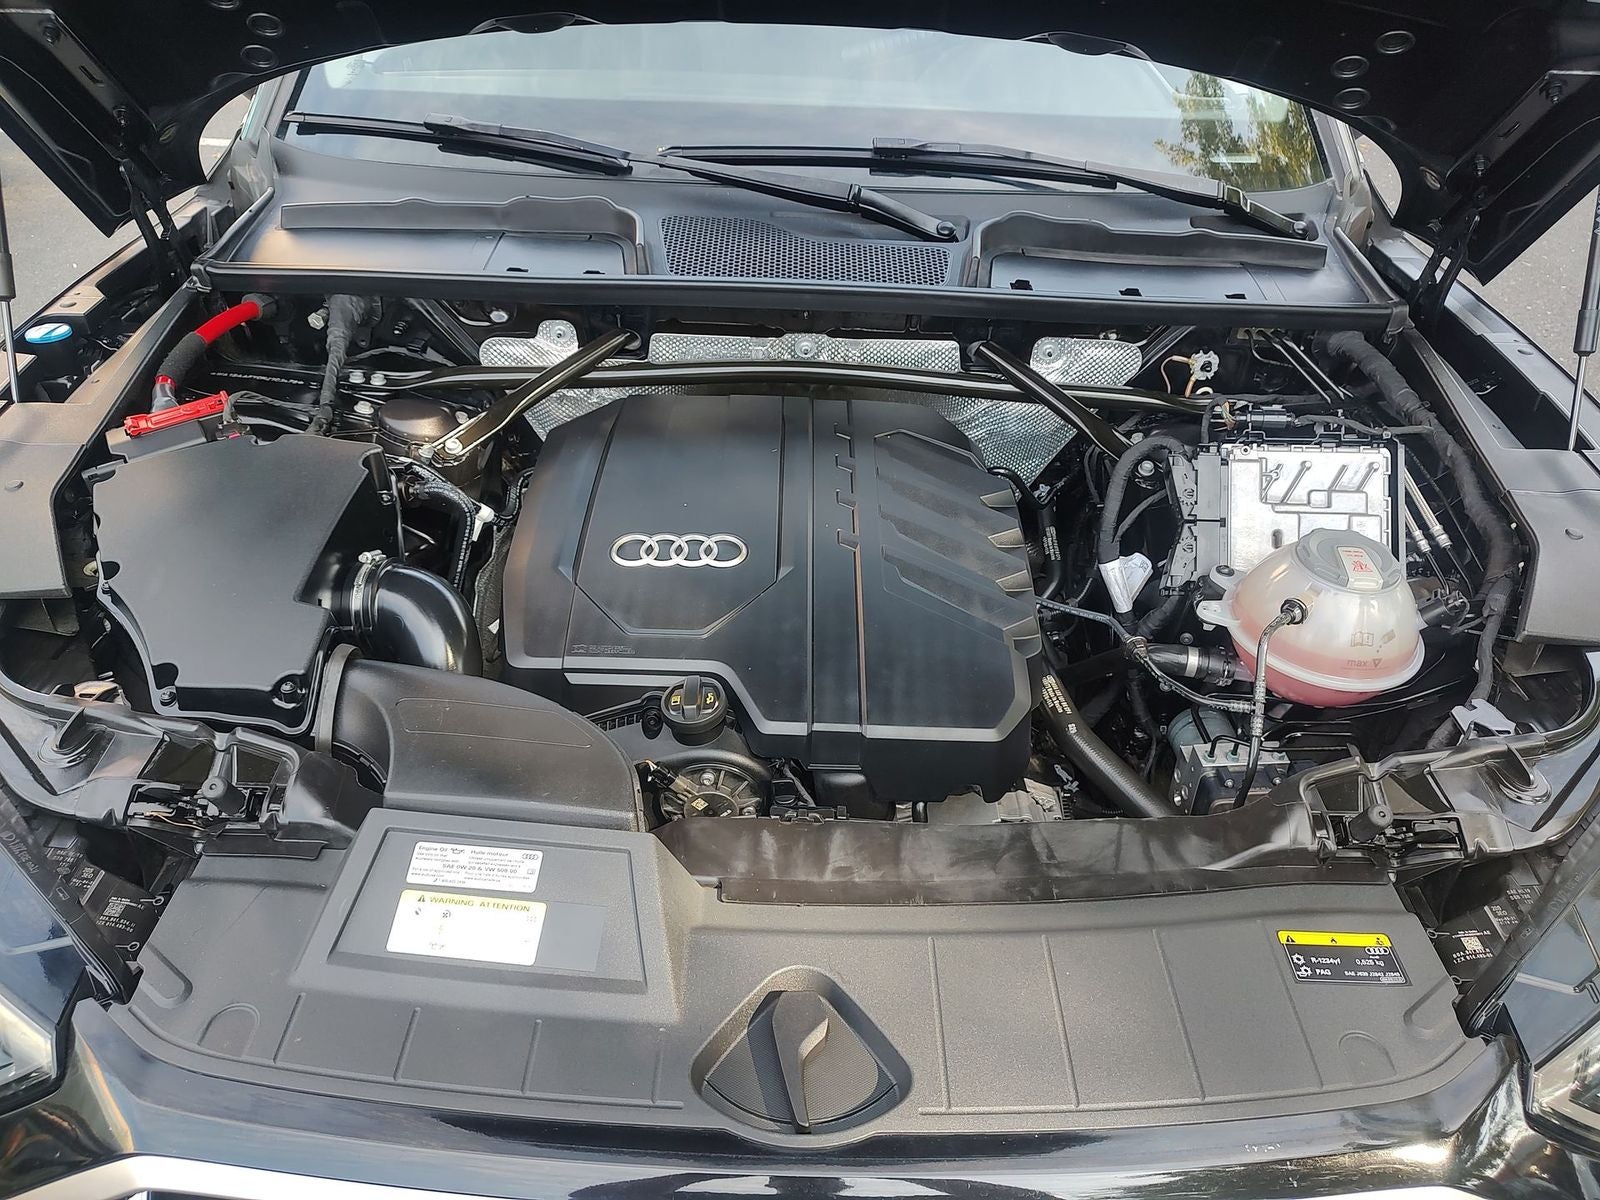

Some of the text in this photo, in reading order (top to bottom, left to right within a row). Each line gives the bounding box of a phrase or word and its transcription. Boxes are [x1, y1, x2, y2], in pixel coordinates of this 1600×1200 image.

[1347, 659, 1368, 667] max
[430, 896, 530, 912] WARNING ATTENTION
[1315, 968, 1332, 976] PAG
